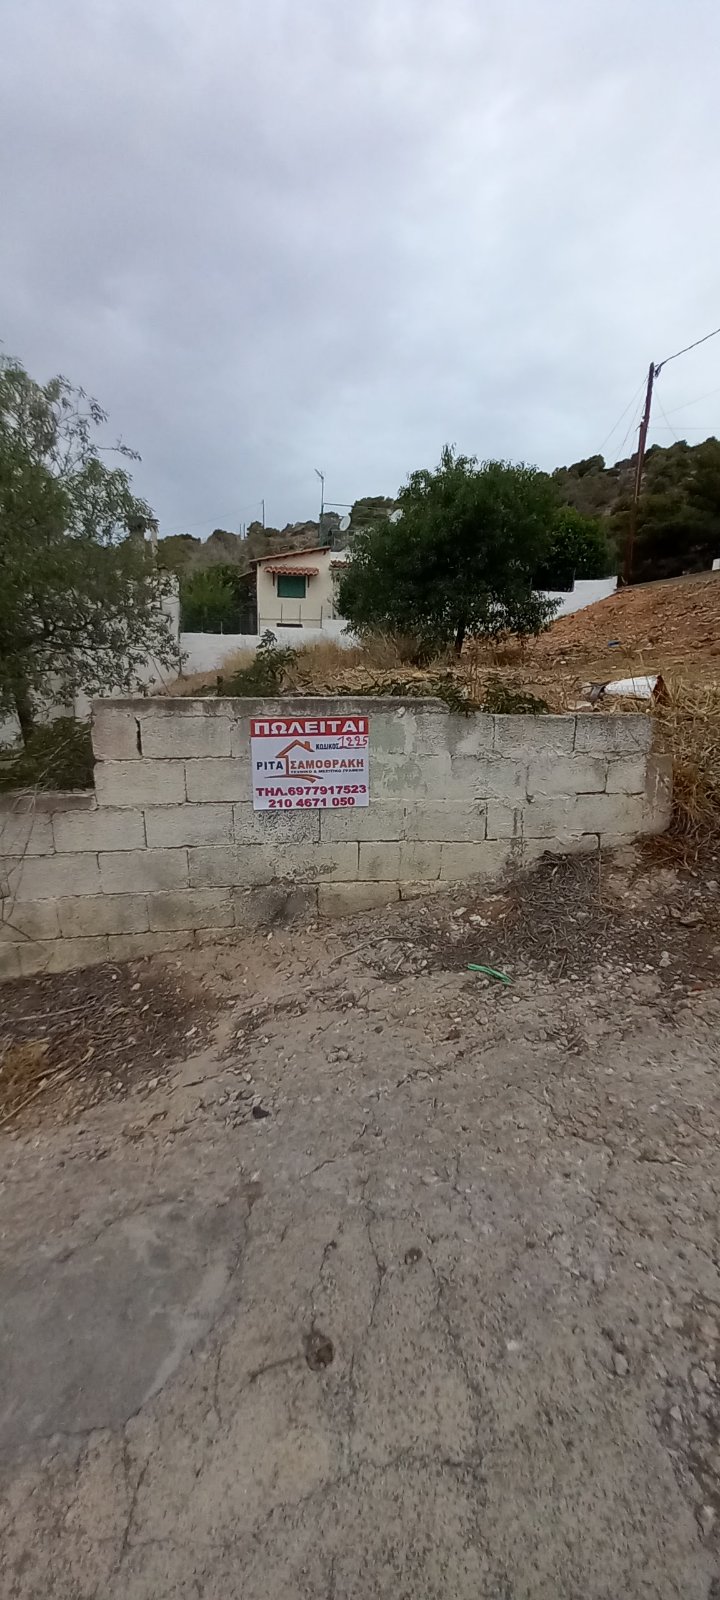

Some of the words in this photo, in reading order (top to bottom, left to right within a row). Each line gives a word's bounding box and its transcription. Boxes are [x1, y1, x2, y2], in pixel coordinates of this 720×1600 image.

[254, 720, 365, 735] ΠΩΛΕΙΤΑΙ
[337, 735, 369, 747] 1225
[256, 761, 284, 770] ΡΙΤΑ
[290, 759, 364, 769] ΣΑΜΟΘΡΑΚΗ
[268, 799, 292, 808] 210
[296, 798, 327, 807] 4671
[331, 797, 355, 806] 050
